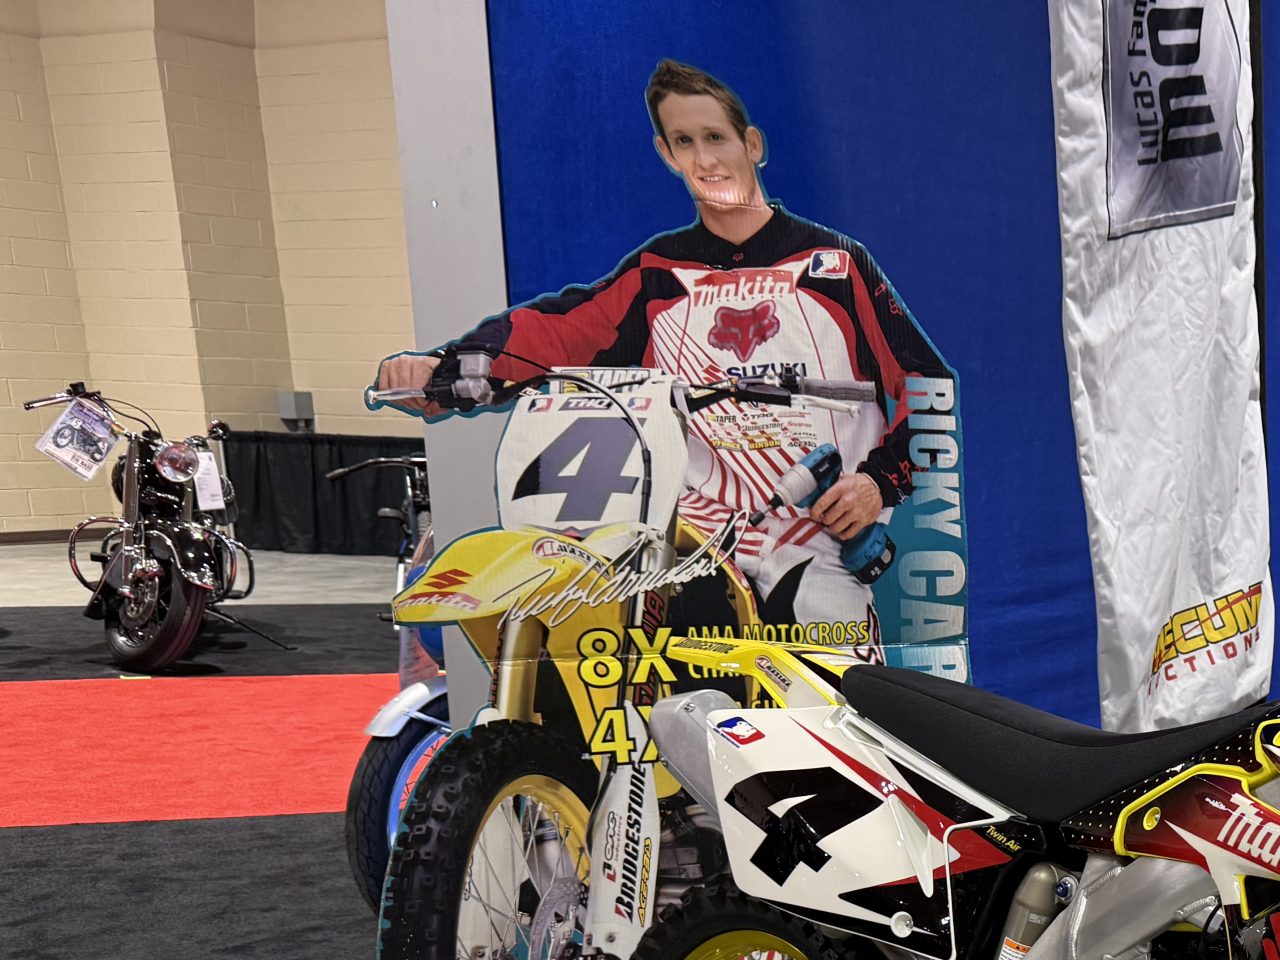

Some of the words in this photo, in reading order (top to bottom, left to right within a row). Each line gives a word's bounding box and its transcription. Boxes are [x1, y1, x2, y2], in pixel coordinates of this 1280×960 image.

[1129, 71, 1160, 166] Lucas
[693, 276, 790, 308] makita
[511, 417, 648, 522] 4
[905, 377, 964, 538] RICKY
[577, 626, 677, 688] 8X
[743, 621, 870, 646] MOTOCROSS
[614, 761, 648, 926] BRIDGESTONE
[985, 825, 1005, 845] Twin
[1002, 838, 1022, 853] Air
